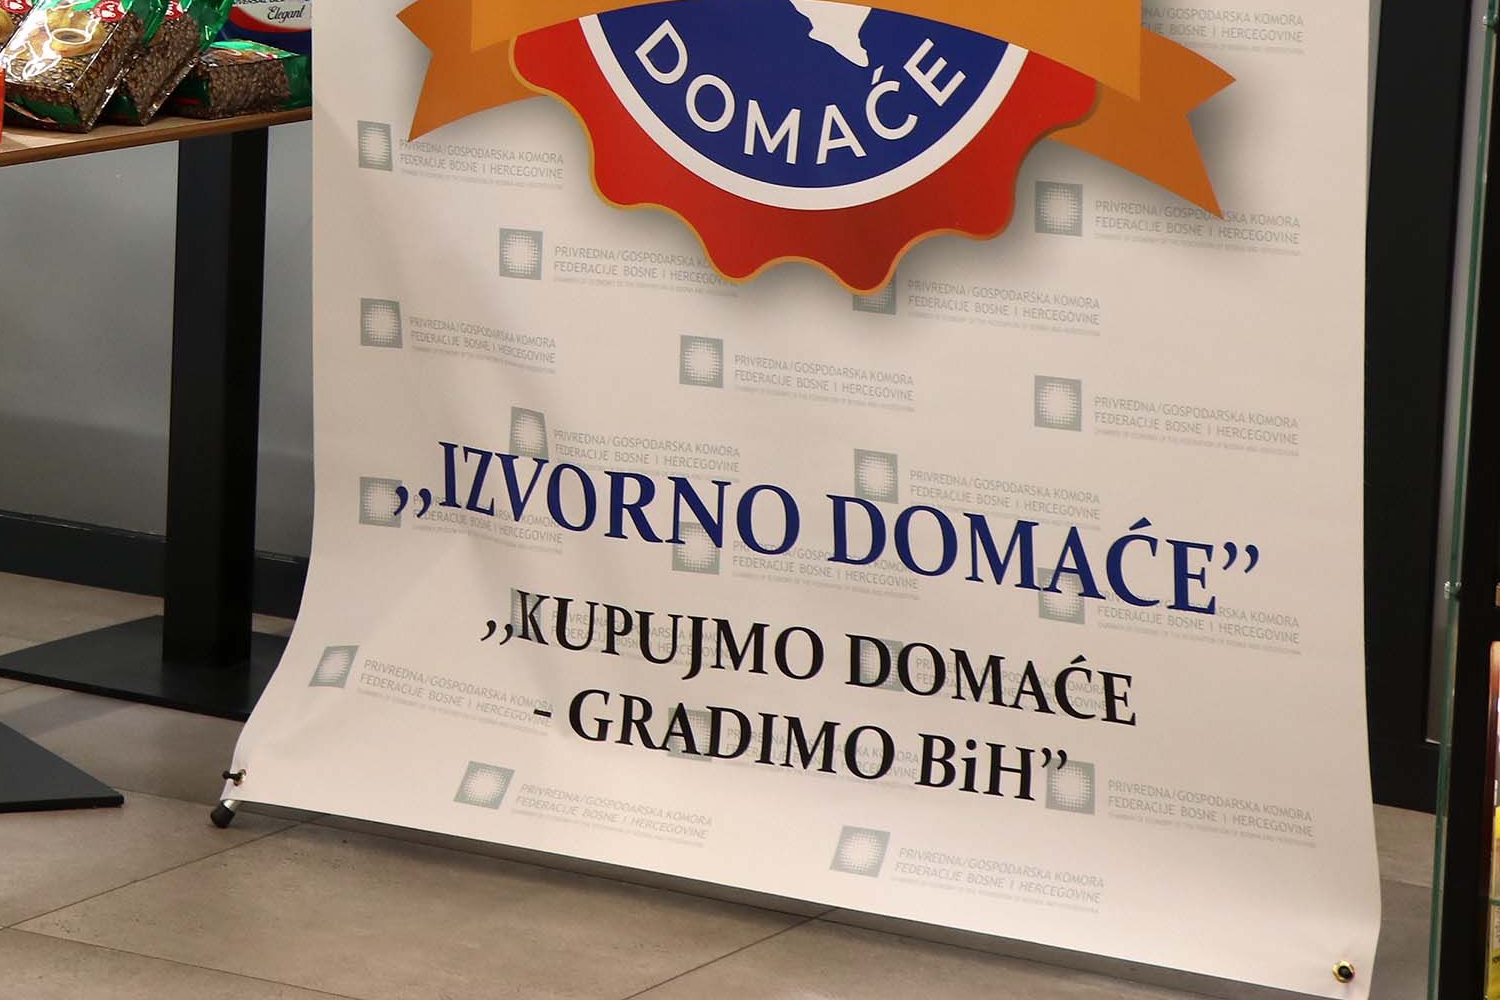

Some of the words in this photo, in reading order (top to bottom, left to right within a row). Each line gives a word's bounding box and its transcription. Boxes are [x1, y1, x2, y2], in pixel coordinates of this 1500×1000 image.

[268, 5, 306, 23] Elegant
[634, 19, 968, 166] DOMAĆE
[845, 634, 1136, 726] DOMAĆE
[568, 689, 895, 780] GRADIMO
